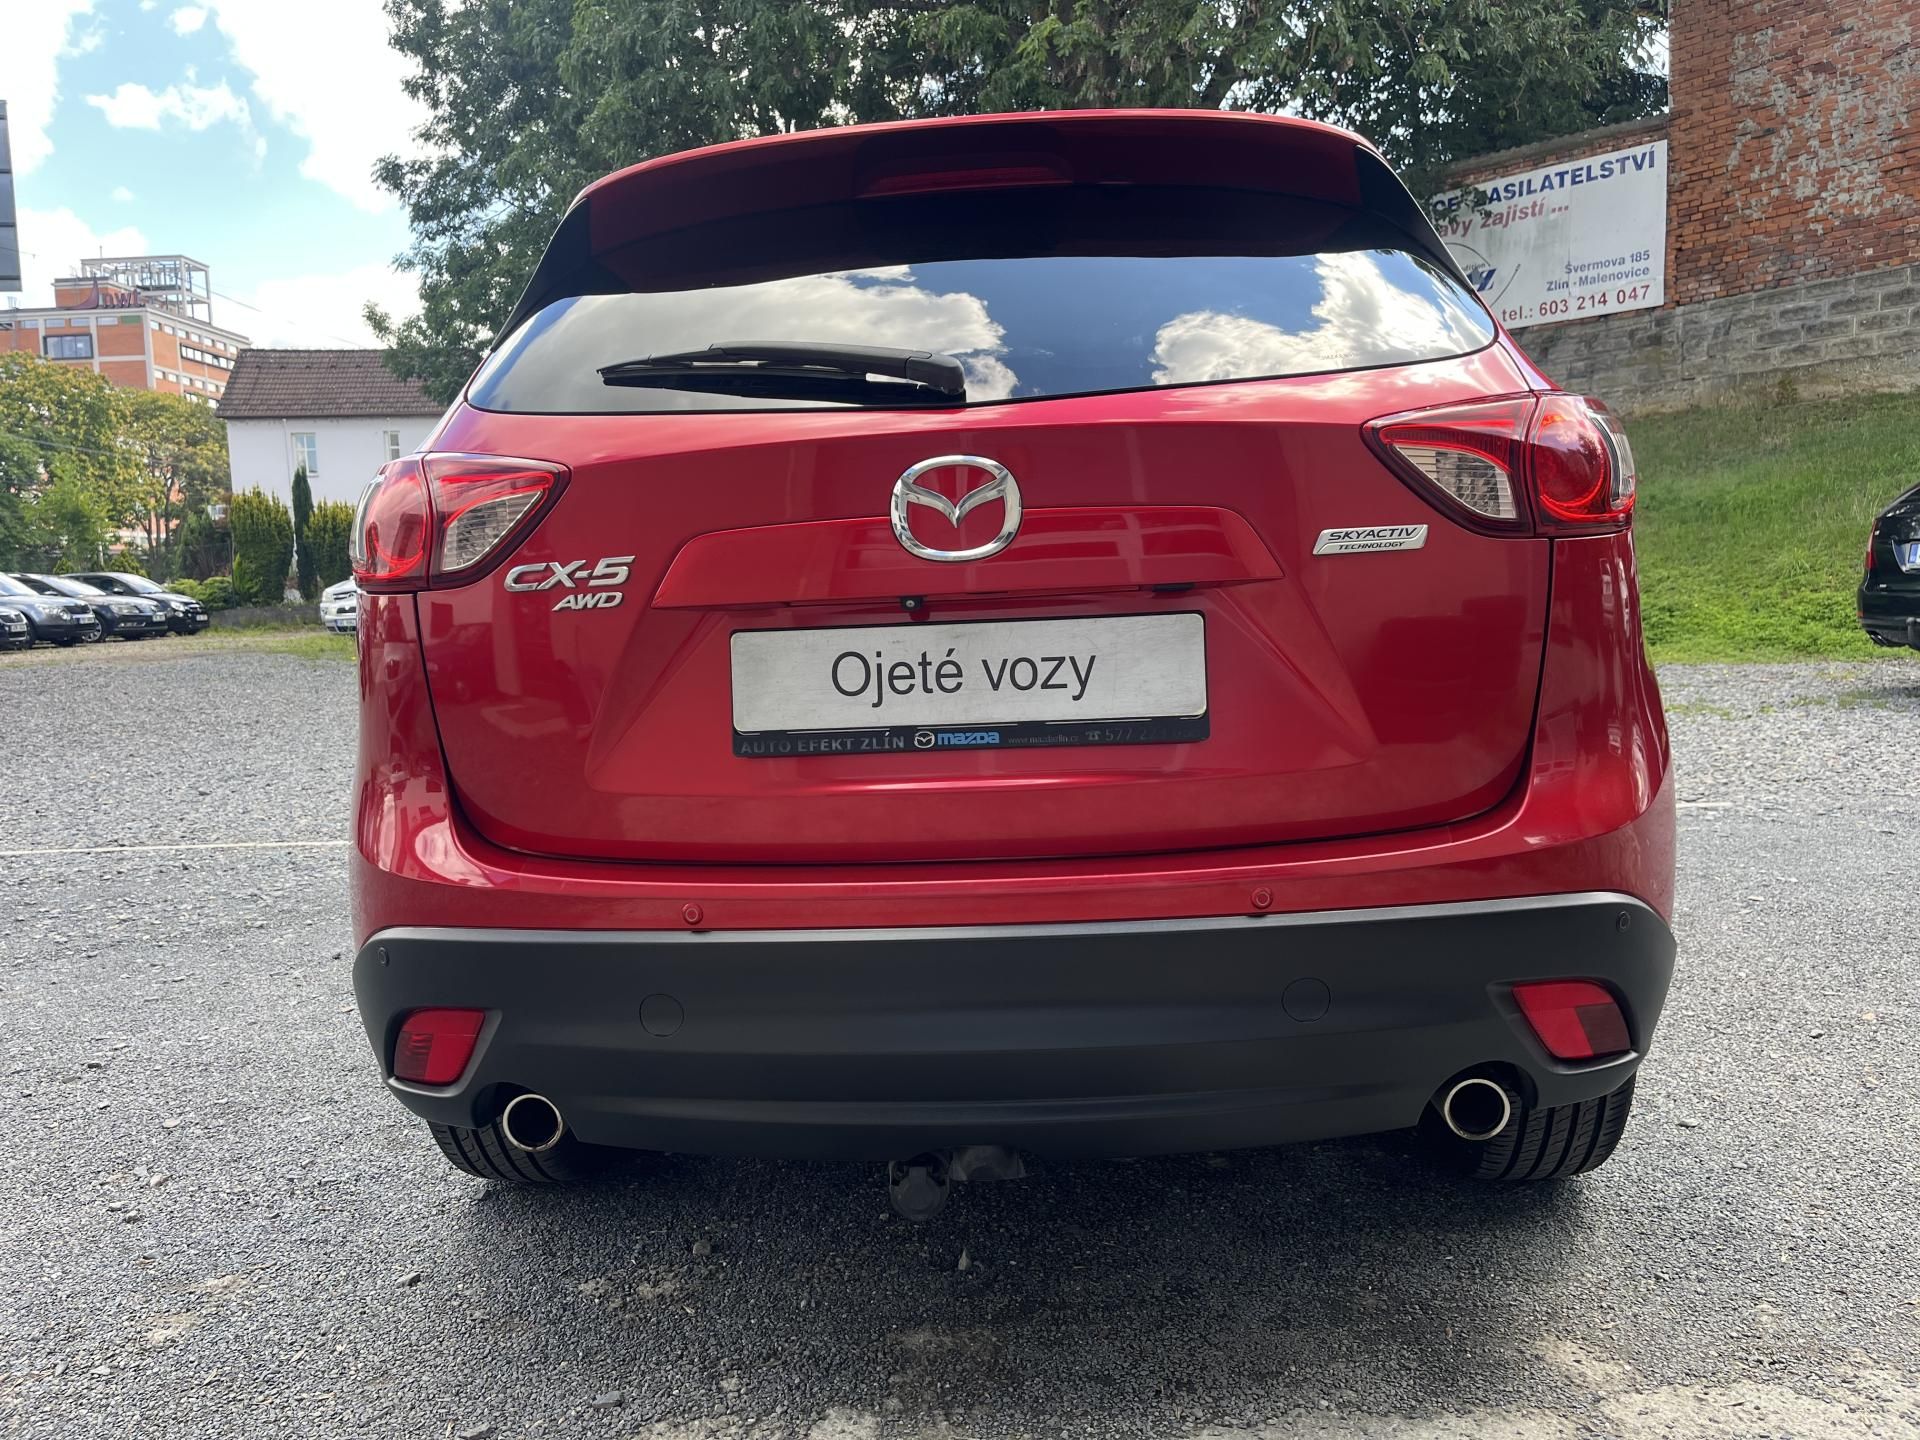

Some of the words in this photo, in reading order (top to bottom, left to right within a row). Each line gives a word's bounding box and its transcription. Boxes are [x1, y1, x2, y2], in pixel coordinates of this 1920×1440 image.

[1474, 145, 1656, 208] ASILATELSTVÍ
[1630, 249, 1651, 264] 185
[1578, 266, 1651, 287] Malenovice
[1502, 306, 1534, 322] tel.:
[1539, 298, 1570, 317] 603
[1576, 291, 1609, 311] 214
[1616, 284, 1651, 305] 047
[1327, 527, 1418, 541] SKYACTIV
[1338, 541, 1405, 551] TECHNOLOGY
[503, 555, 636, 592] CX-5
[551, 591, 623, 612] AWD
[831, 647, 964, 708] Ojeté
[981, 654, 1097, 701] vozy
[741, 739, 791, 754] AUTO
[798, 737, 854, 752] EFEKT
[860, 731, 905, 750] ZLÍN
